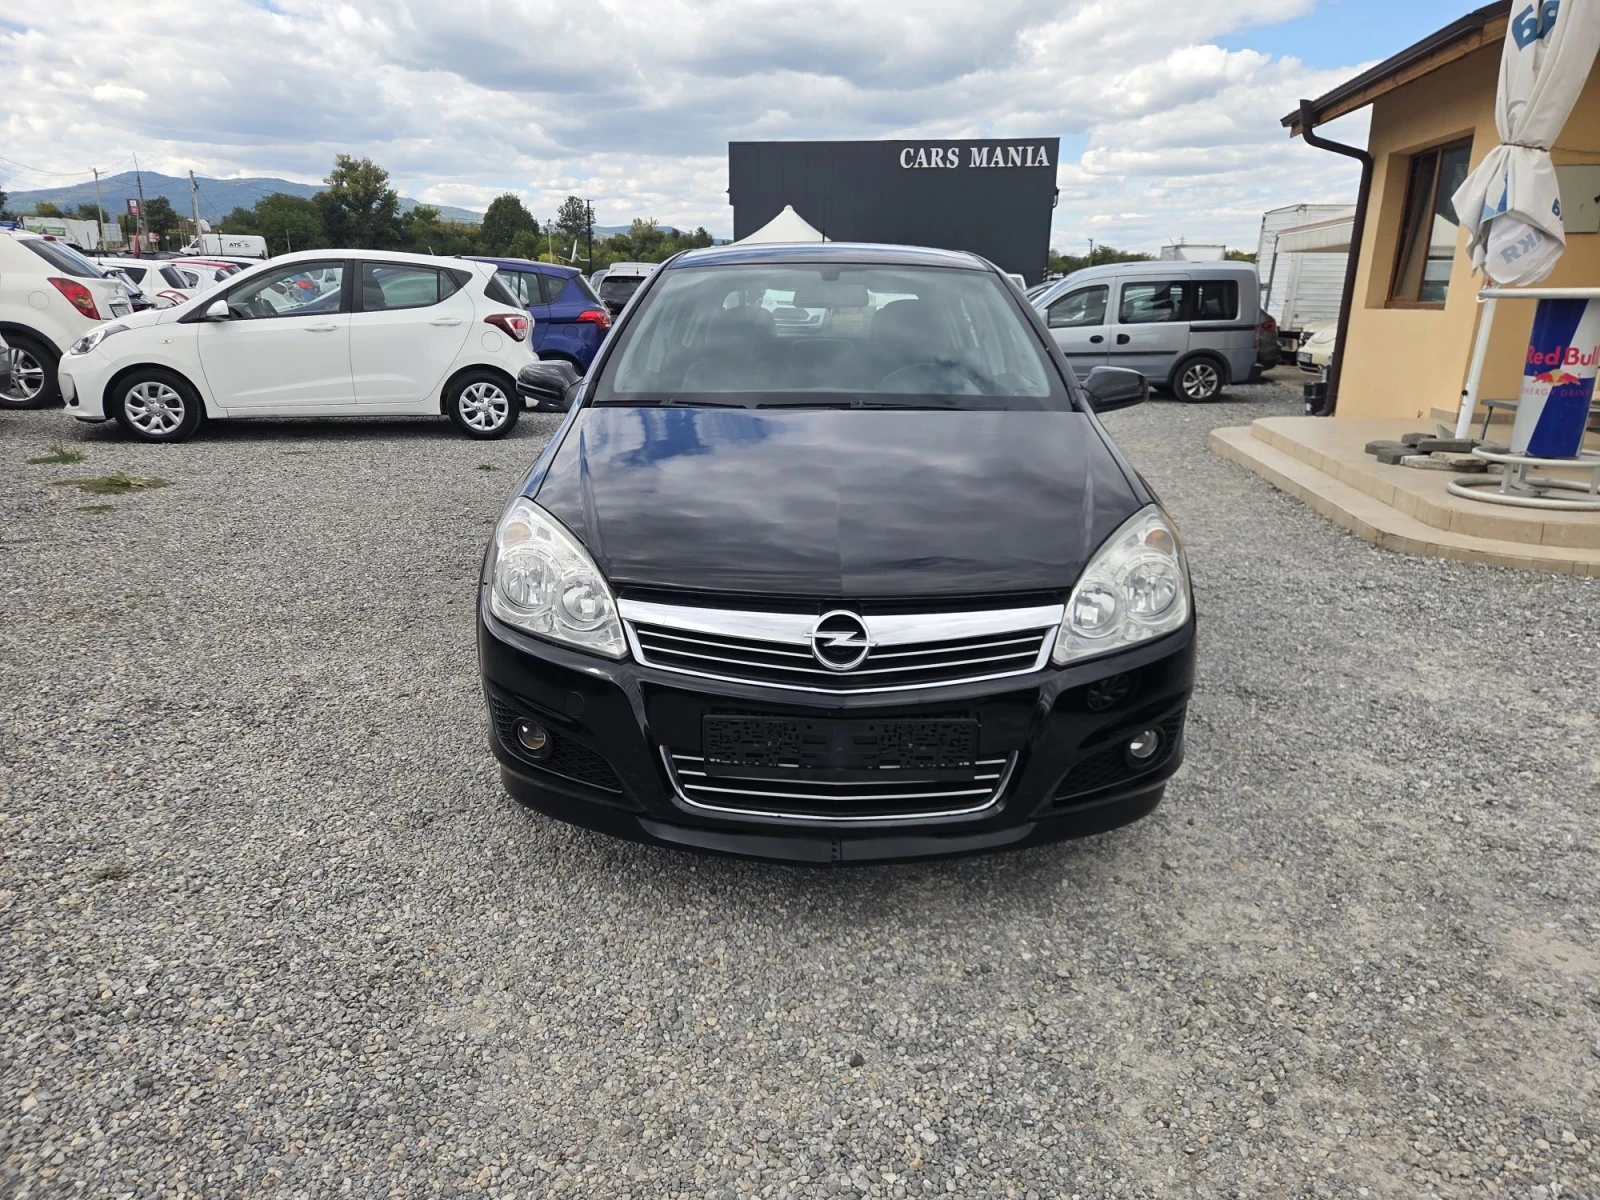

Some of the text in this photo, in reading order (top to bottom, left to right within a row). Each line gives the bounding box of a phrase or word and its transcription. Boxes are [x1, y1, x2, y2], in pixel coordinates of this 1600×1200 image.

[900, 145, 1050, 168] CARS MANIA
[1526, 345, 1600, 366] Red Bull
